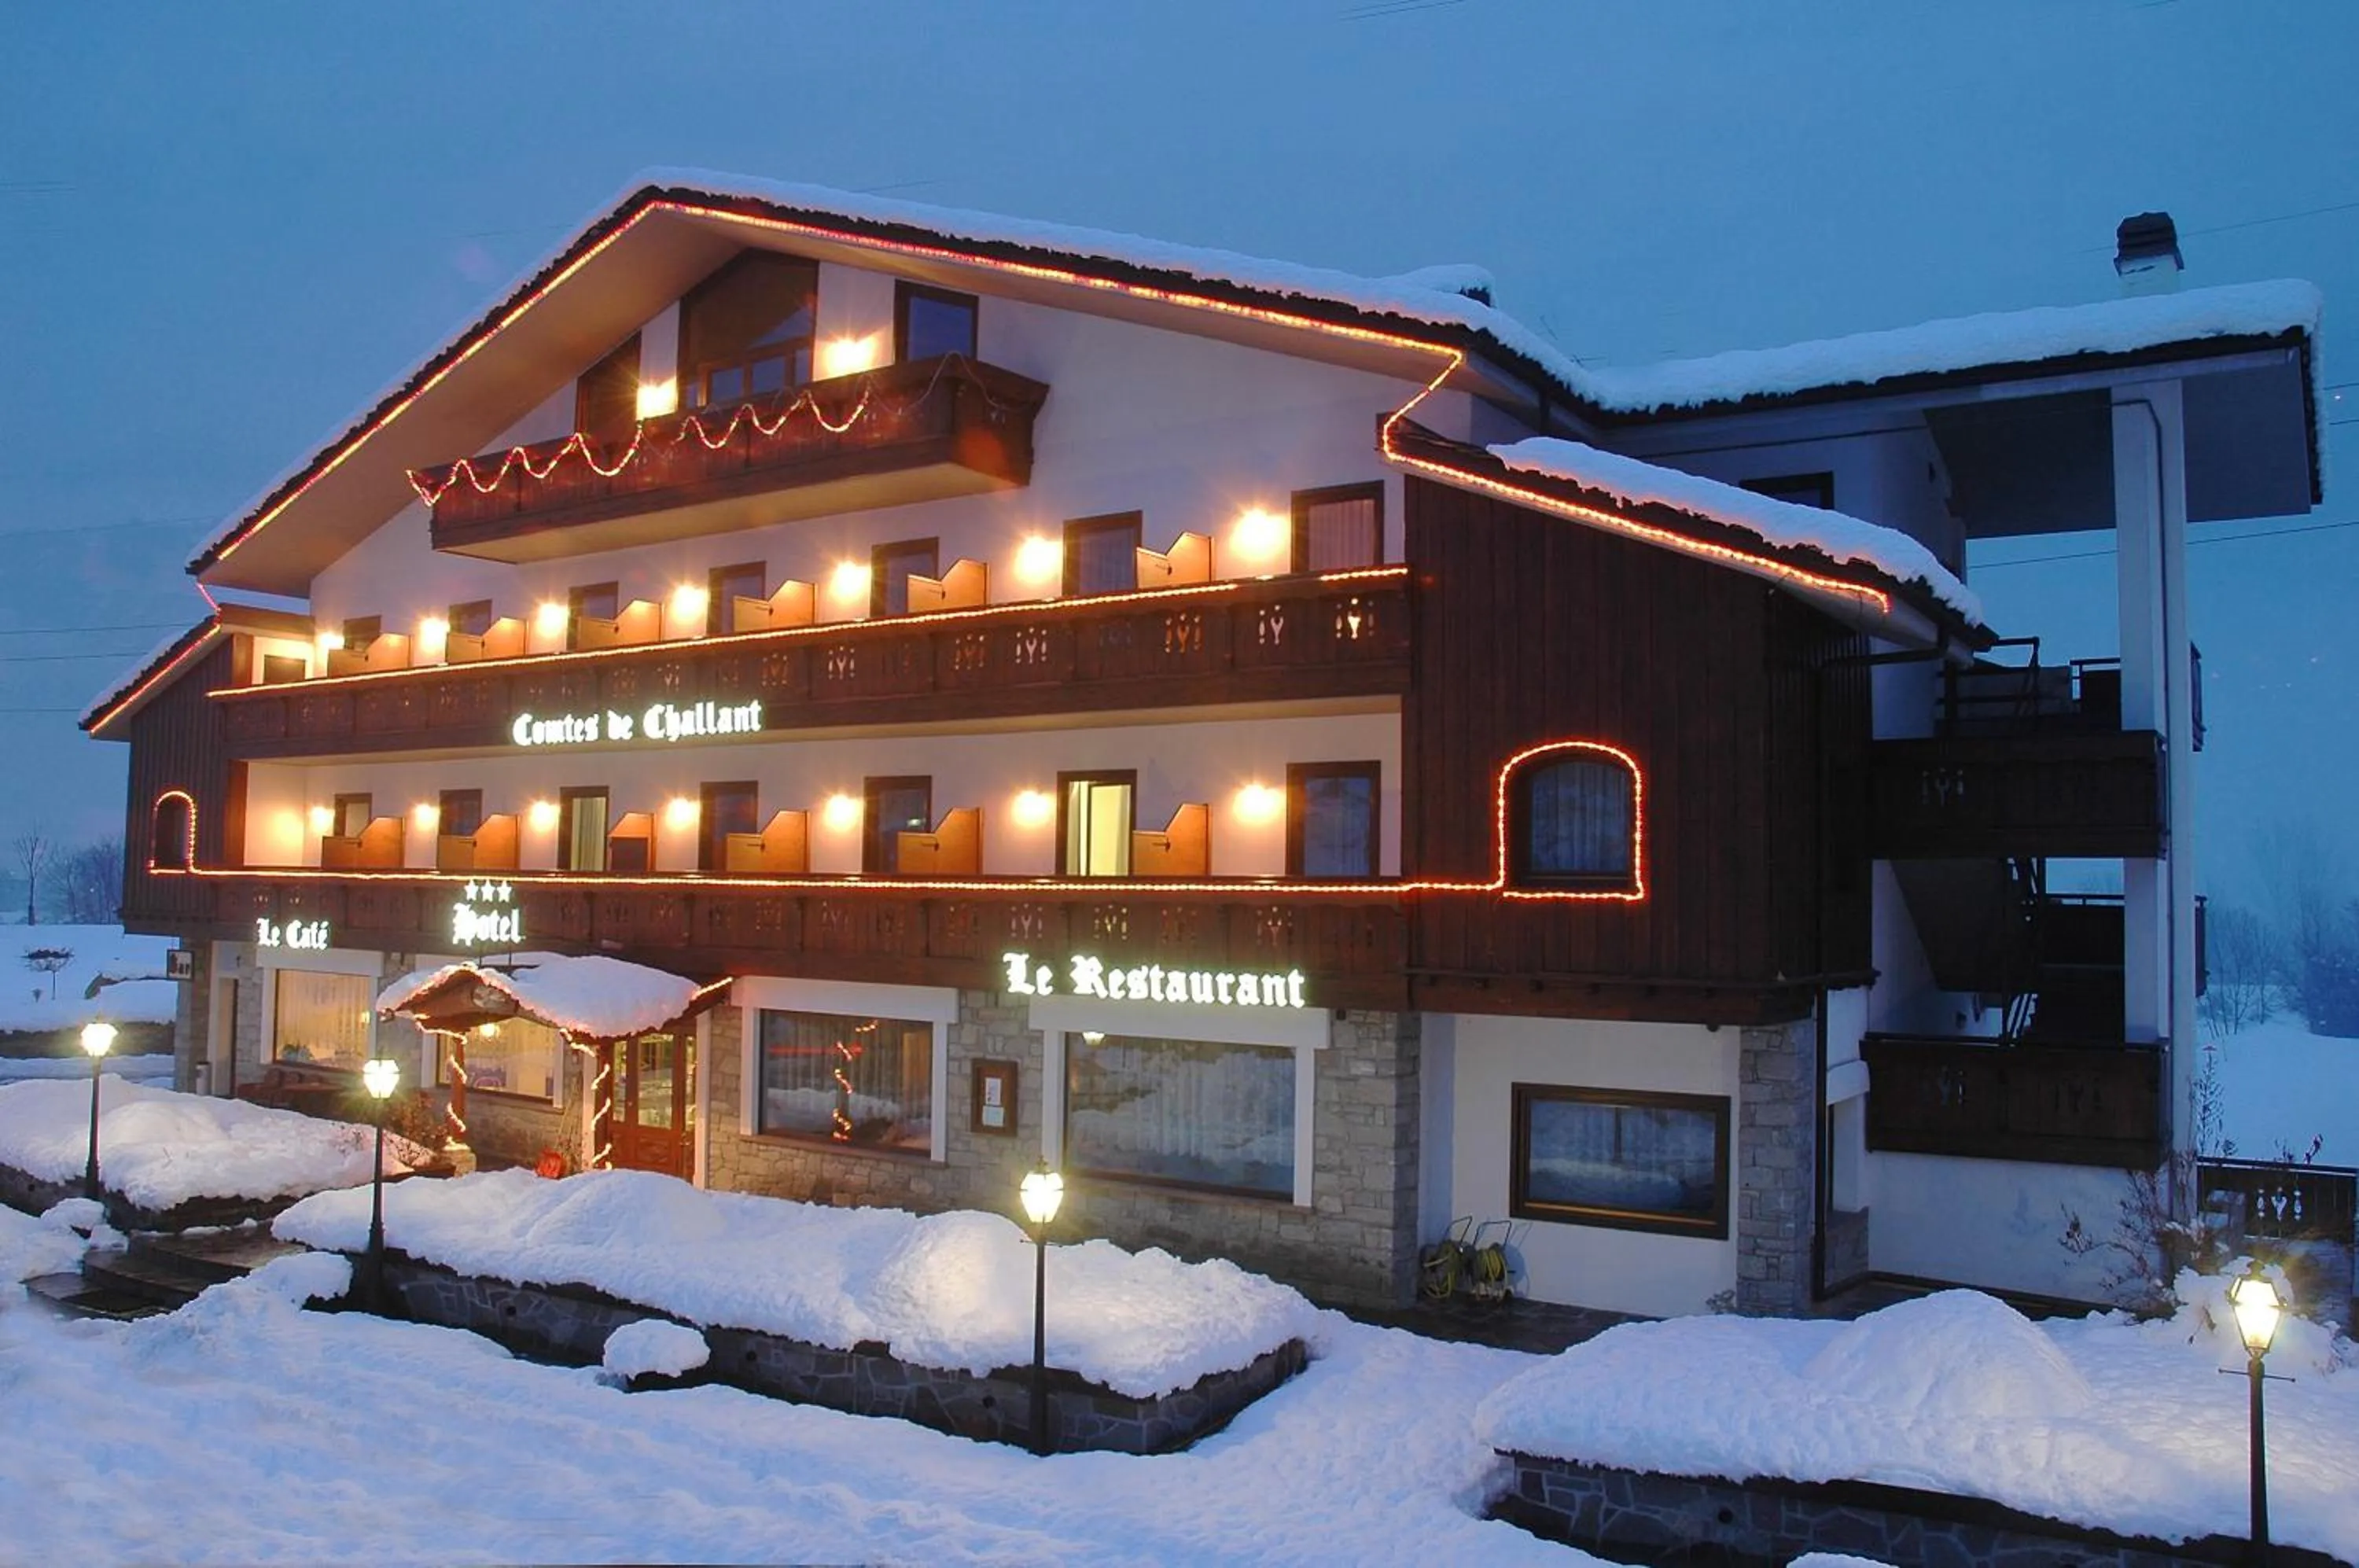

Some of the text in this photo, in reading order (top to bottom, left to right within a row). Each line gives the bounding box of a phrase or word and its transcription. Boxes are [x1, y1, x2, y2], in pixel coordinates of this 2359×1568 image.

[513, 701, 762, 745] Comtes de Challant
[257, 918, 328, 950] Le Café
[453, 903, 521, 946] Hotel
[169, 953, 190, 975] Bar
[1003, 953, 1305, 1008] Le Restaurant
